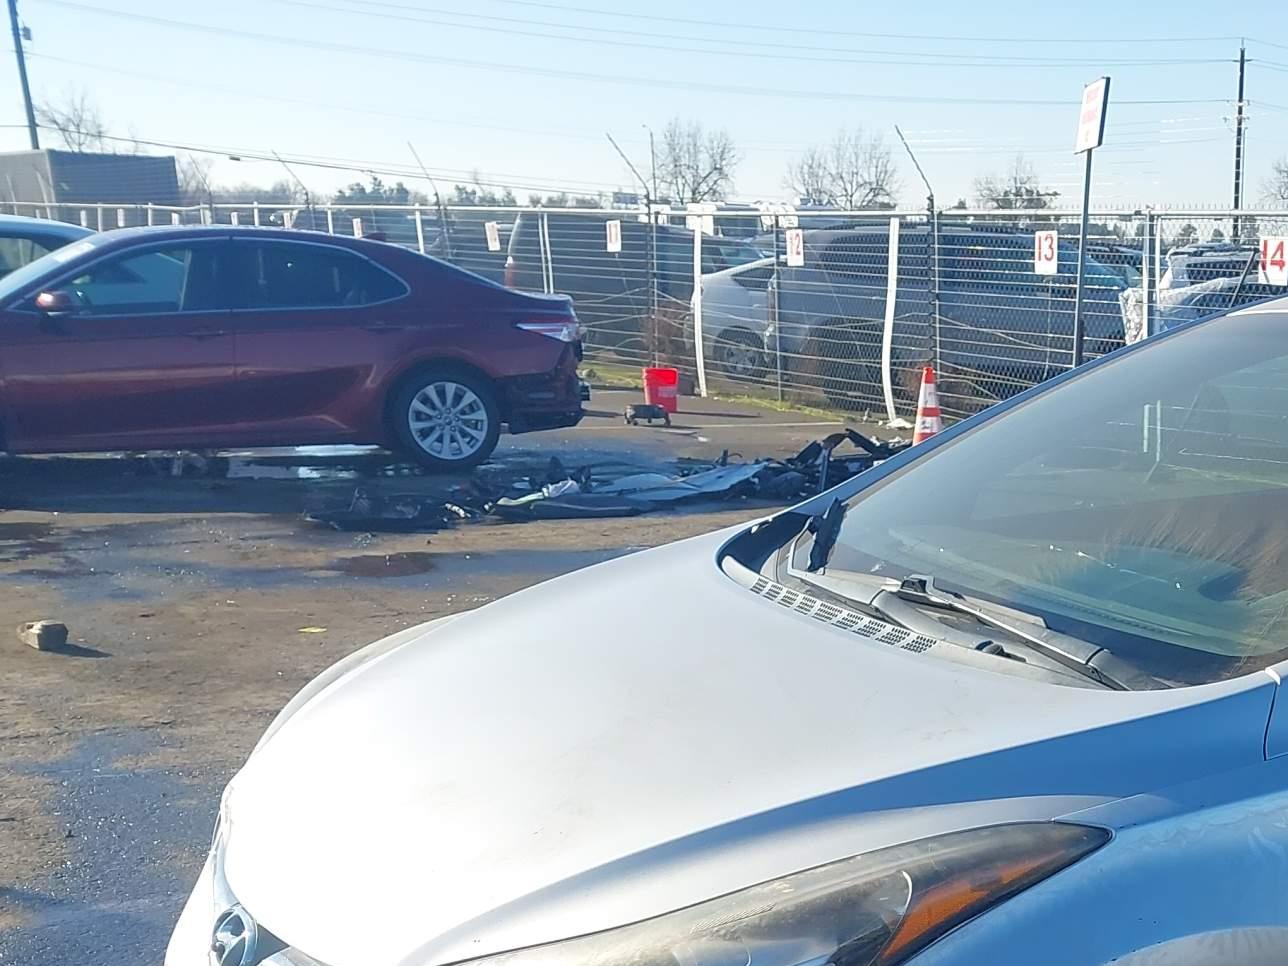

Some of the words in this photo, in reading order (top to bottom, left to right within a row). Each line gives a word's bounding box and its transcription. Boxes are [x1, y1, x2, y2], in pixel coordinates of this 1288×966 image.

[789, 232, 802, 256] 12
[1037, 234, 1055, 261] 13
[1260, 239, 1286, 272] 14
